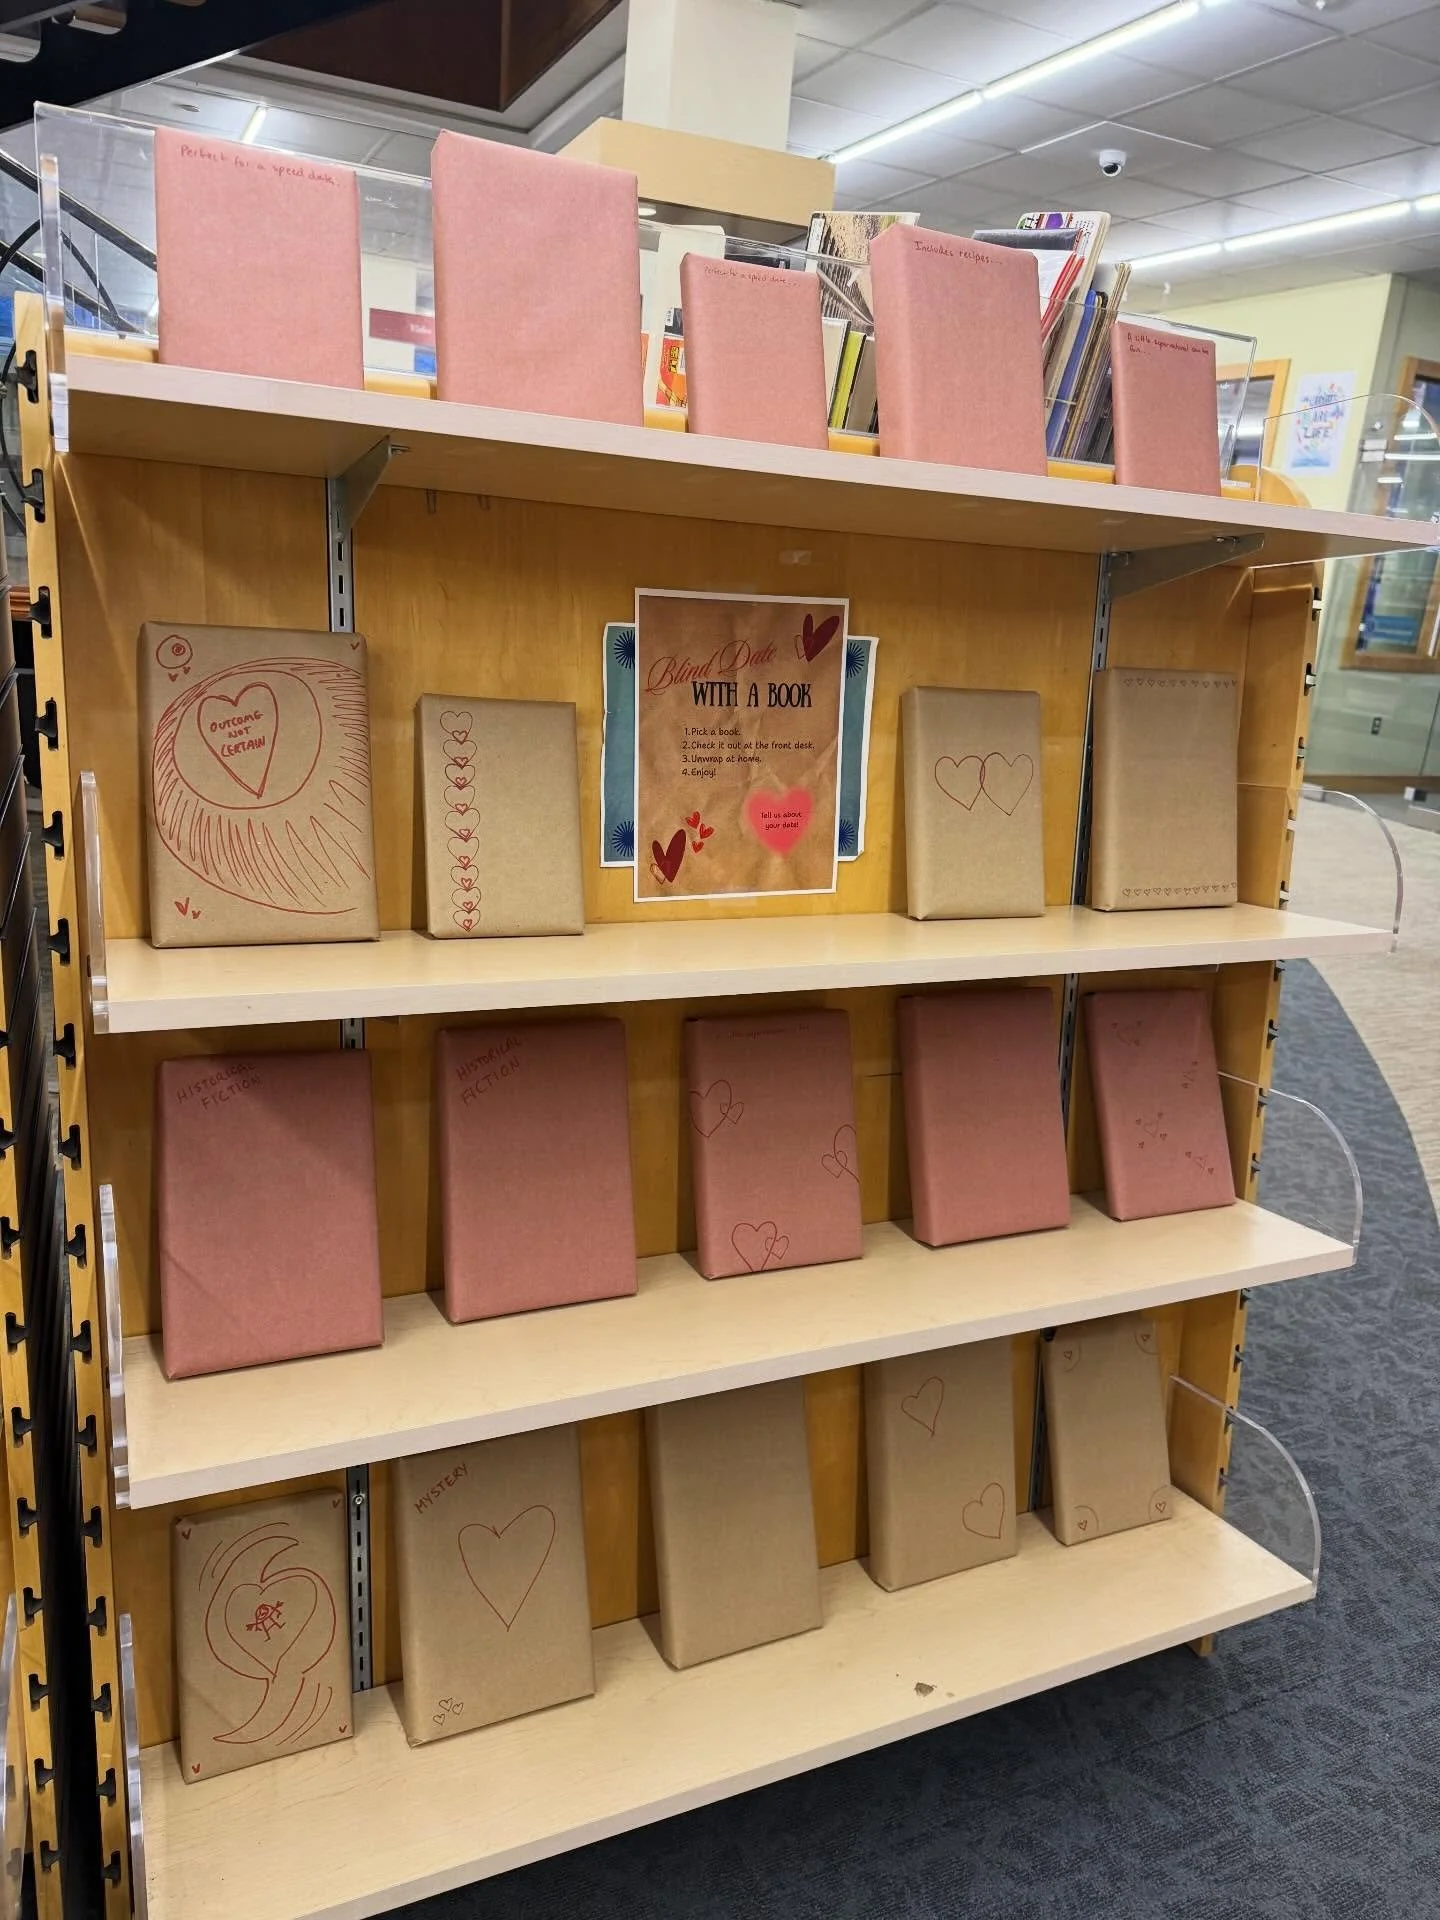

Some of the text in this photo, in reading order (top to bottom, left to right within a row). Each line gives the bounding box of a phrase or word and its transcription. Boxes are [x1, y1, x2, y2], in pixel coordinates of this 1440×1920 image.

[234, 155, 249, 168] for
[256, 163, 266, 171] a
[272, 164, 304, 178] speed
[913, 240, 954, 257] Includes
[645, 639, 777, 696] Blind Date
[692, 680, 812, 708] WITH A BOOK
[210, 710, 264, 733] OUTCOME
[228, 725, 252, 739] NOT
[719, 727, 741, 736] book.
[220, 735, 266, 758] CERTAIN
[718, 741, 725, 750] it
[727, 742, 741, 750] out
[743, 742, 753, 750] at
[755, 741, 769, 750] the
[771, 741, 792, 751] front
[794, 741, 815, 750] desk.
[725, 755, 736, 763] at
[737, 754, 762, 764] home.
[760, 811, 772, 819] Tell
[765, 823, 780, 831] your
[456, 1036, 522, 1081] HISTORICAL
[176, 1063, 257, 1105] HISTORICAL
[201, 1073, 264, 1110] FICTION
[461, 1055, 520, 1107] FICTION
[413, 1463, 468, 1515] MYSTERY
